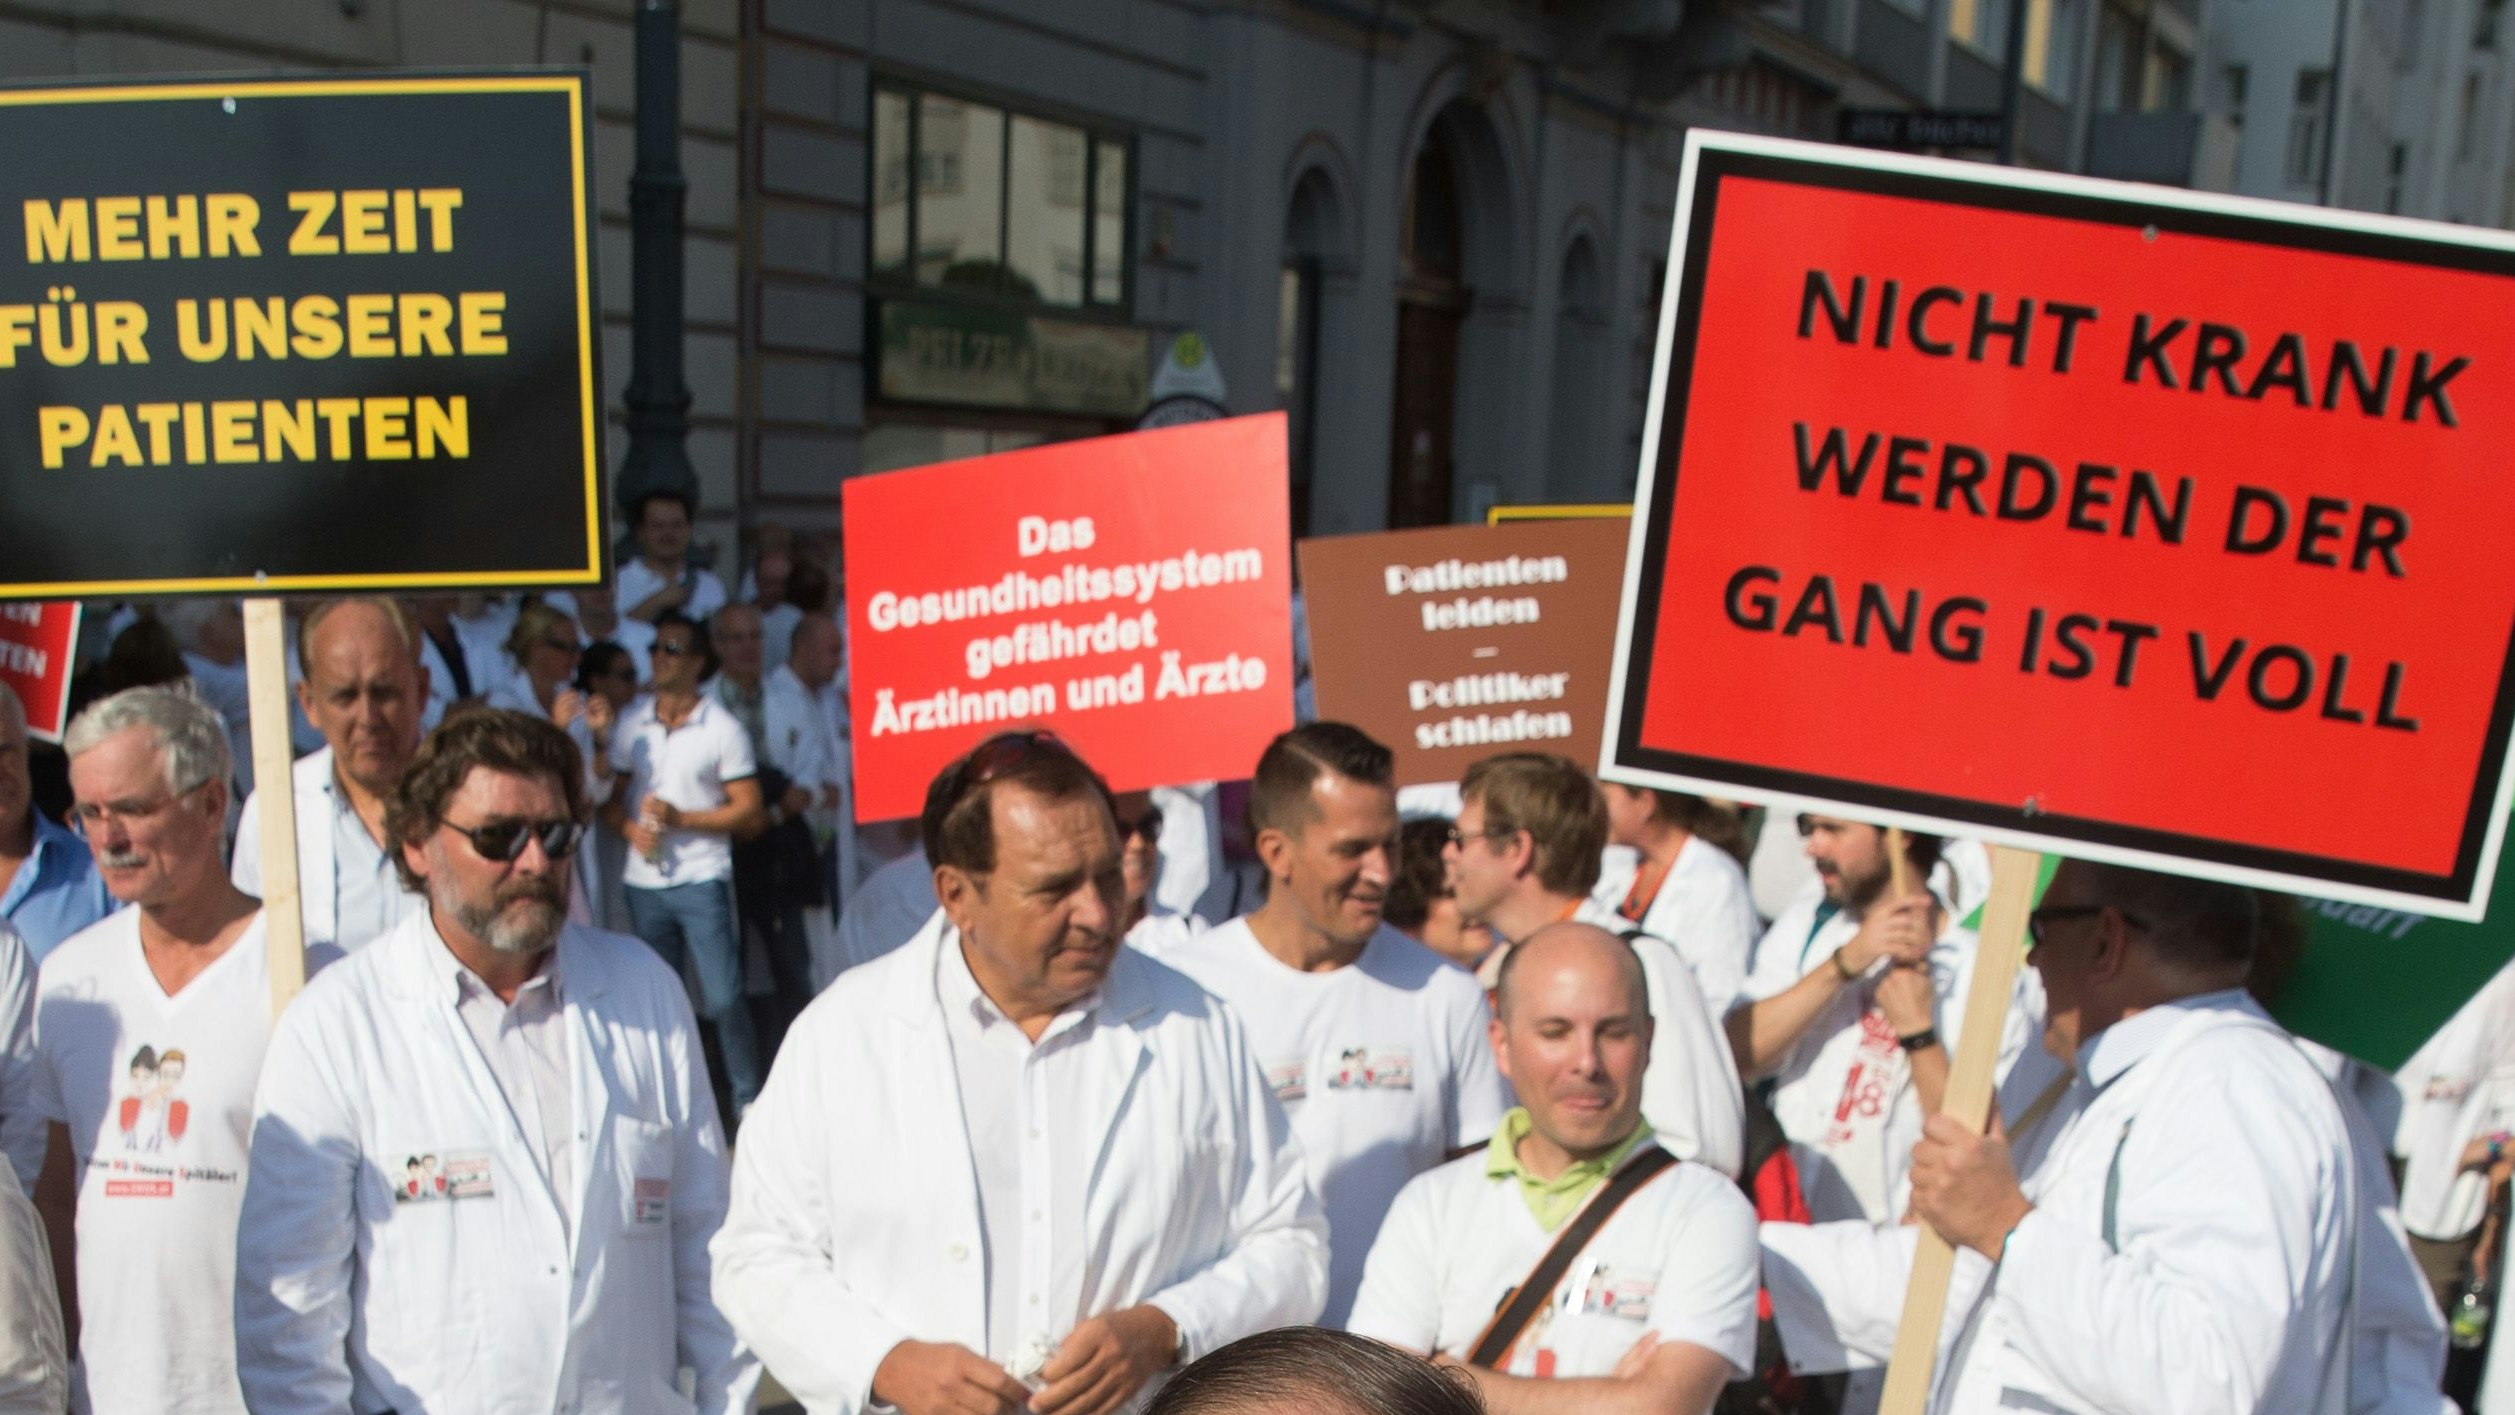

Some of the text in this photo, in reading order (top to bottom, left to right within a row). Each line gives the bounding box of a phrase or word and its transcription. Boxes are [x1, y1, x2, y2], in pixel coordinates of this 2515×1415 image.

[24, 189, 463, 264] MEHR ZEIT
[0, 286, 508, 368] FÜR UNSERE
[1798, 271, 2470, 427] NICHT KRANK
[40, 397, 470, 469] PATIENTEN
[1018, 515, 1096, 558] Das
[1794, 423, 2409, 577] WERDEN DER
[868, 547, 1261, 632] Gesundheitssystem
[1385, 556, 1567, 596] Patienten
[965, 610, 1160, 680] gefährdet
[1422, 597, 1539, 631] leiden
[1725, 566, 2418, 731] GANG IST VOLL
[871, 648, 1268, 737] Ärztinnen und Ärzte
[1409, 673, 1568, 711] Politiker
[1416, 710, 1572, 749] schlafen
